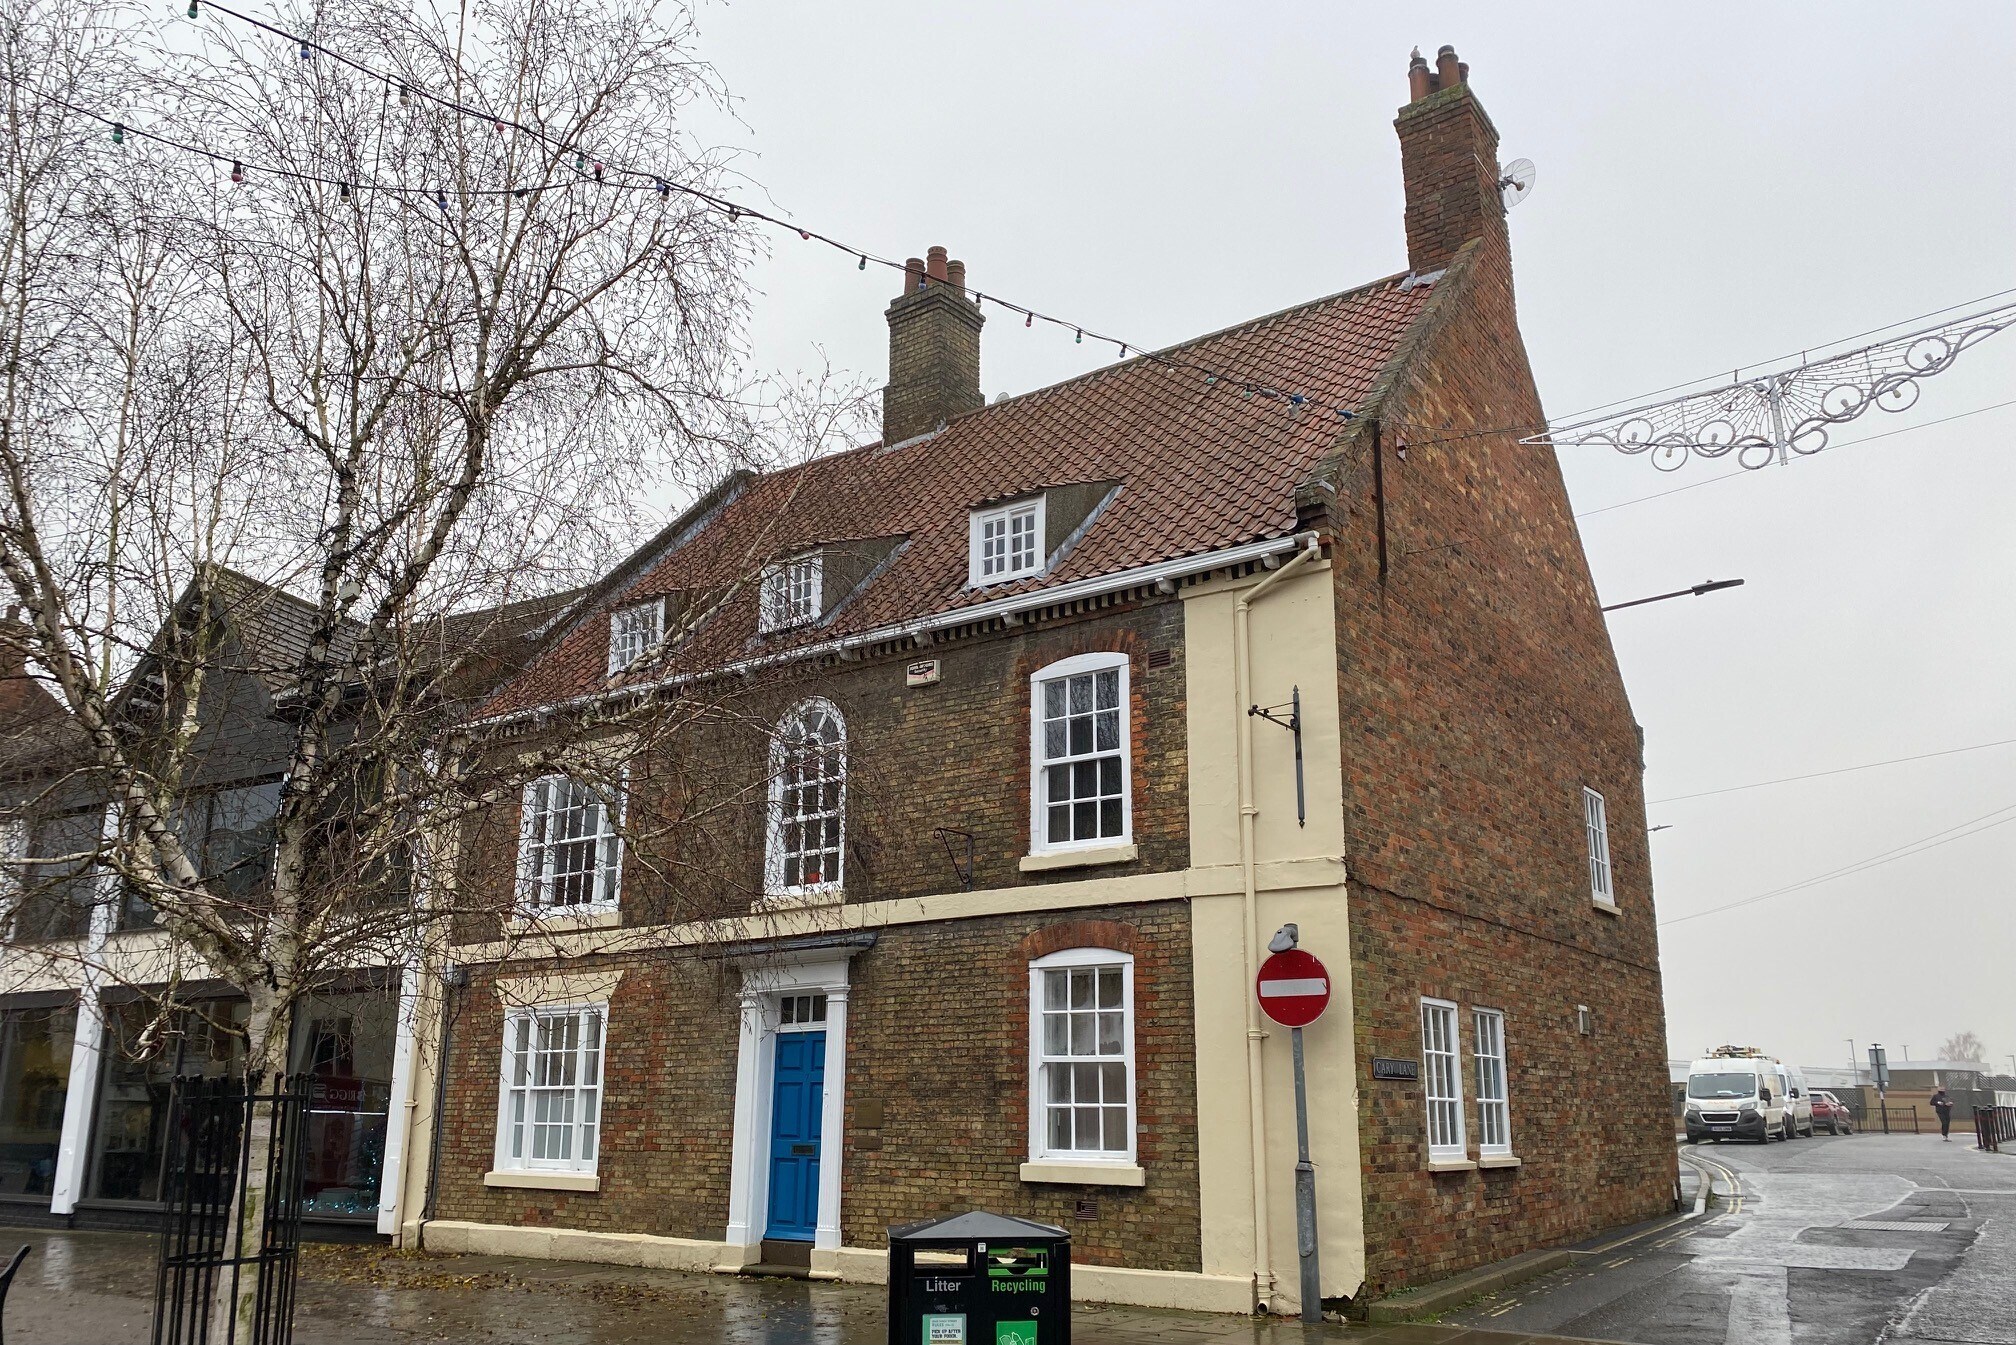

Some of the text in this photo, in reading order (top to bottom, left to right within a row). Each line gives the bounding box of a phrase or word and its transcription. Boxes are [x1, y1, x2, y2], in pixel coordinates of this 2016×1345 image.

[1376, 1062, 1416, 1076] CARY LANE
[926, 1280, 961, 1291] Litter
[992, 1279, 1045, 1293] Recycling
